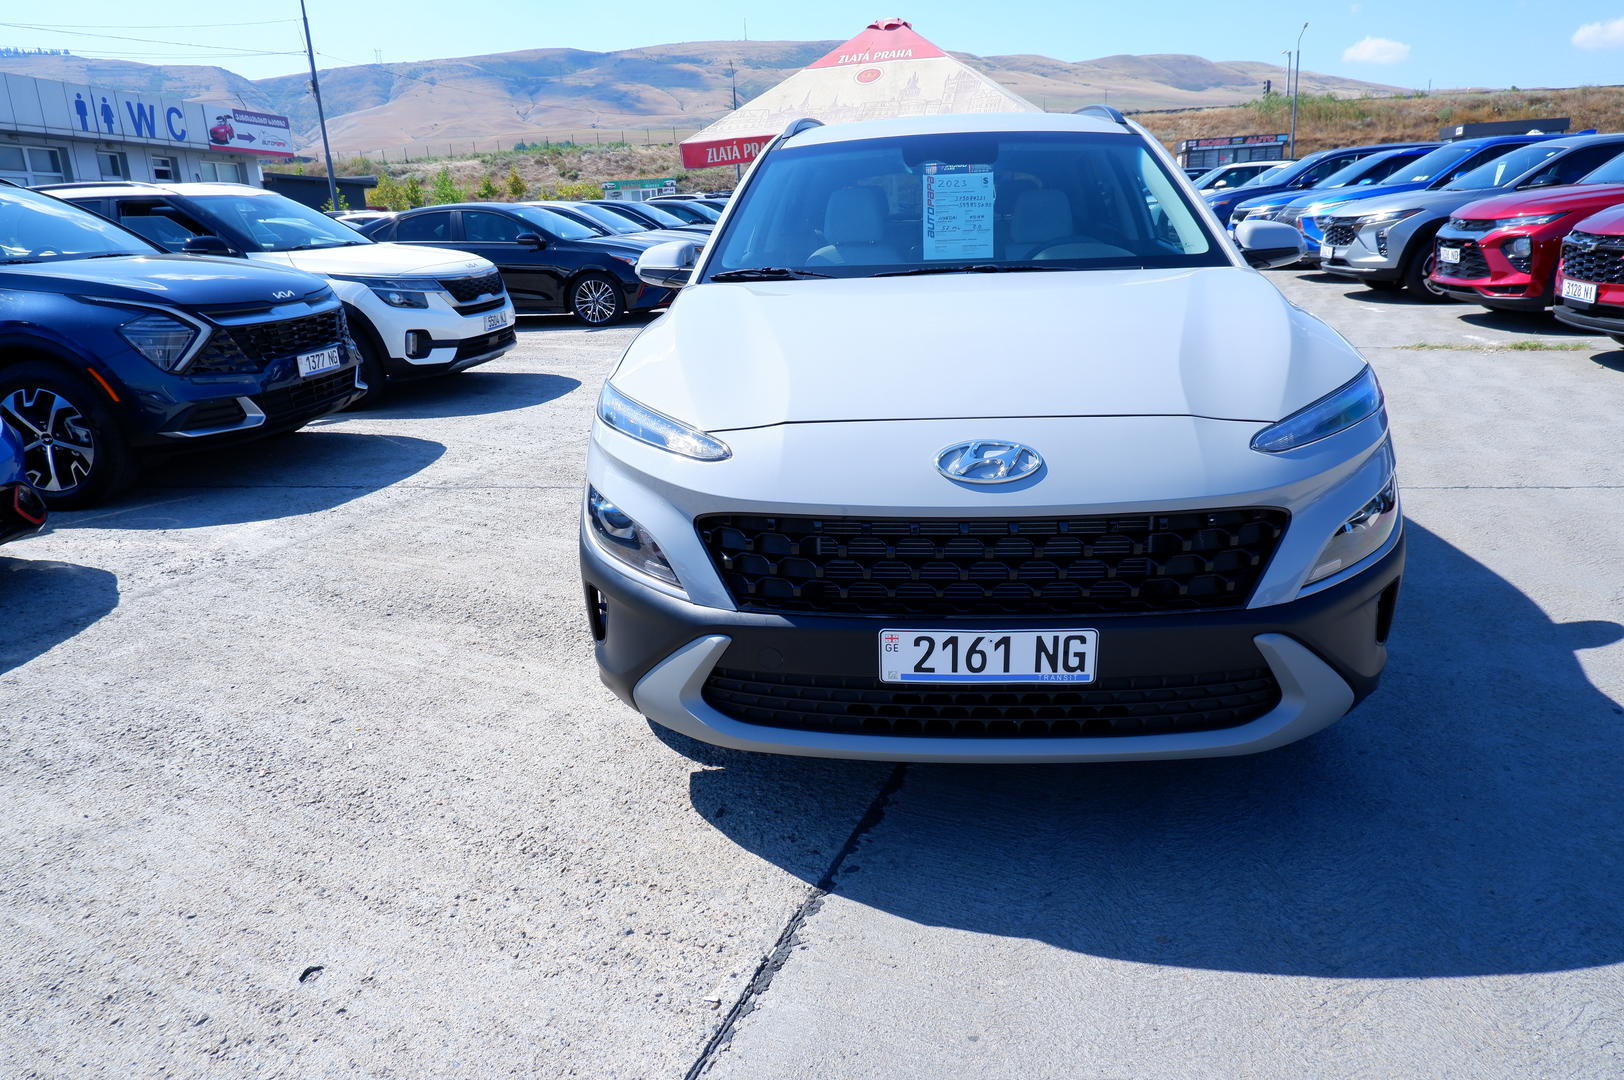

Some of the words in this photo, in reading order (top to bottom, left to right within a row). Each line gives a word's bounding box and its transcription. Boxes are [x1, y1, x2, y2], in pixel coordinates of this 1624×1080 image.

[838, 49, 870, 64] ZLATÁ
[873, 48, 913, 60] PRAHA
[706, 140, 741, 163] ZLATÁ
[938, 179, 967, 188] 2023
[306, 352, 325, 371] 1377
[328, 350, 338, 365] NG
[885, 643, 899, 653] GE
[913, 635, 1012, 673] 2161
[1034, 635, 1087, 673] NG
